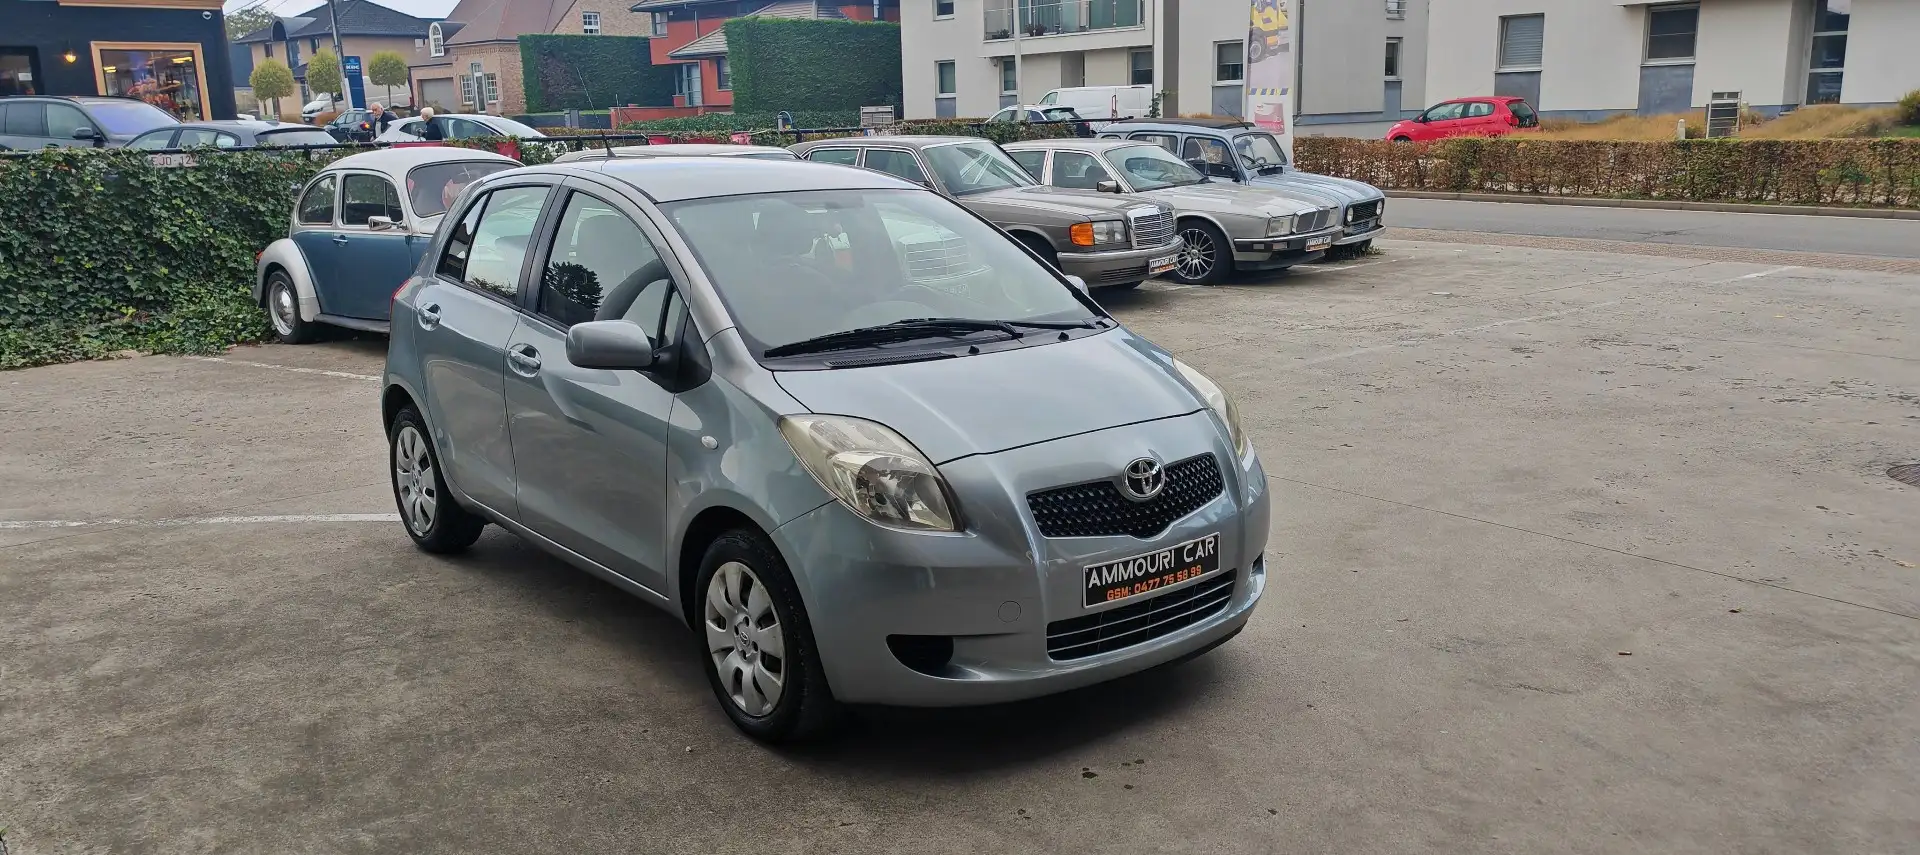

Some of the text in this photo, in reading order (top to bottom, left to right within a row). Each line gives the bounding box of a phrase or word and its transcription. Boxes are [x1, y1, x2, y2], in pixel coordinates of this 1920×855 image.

[1088, 537, 1215, 588] AMMOURI CAR
[1107, 565, 1202, 601] GSM: 0477 75 58 99
